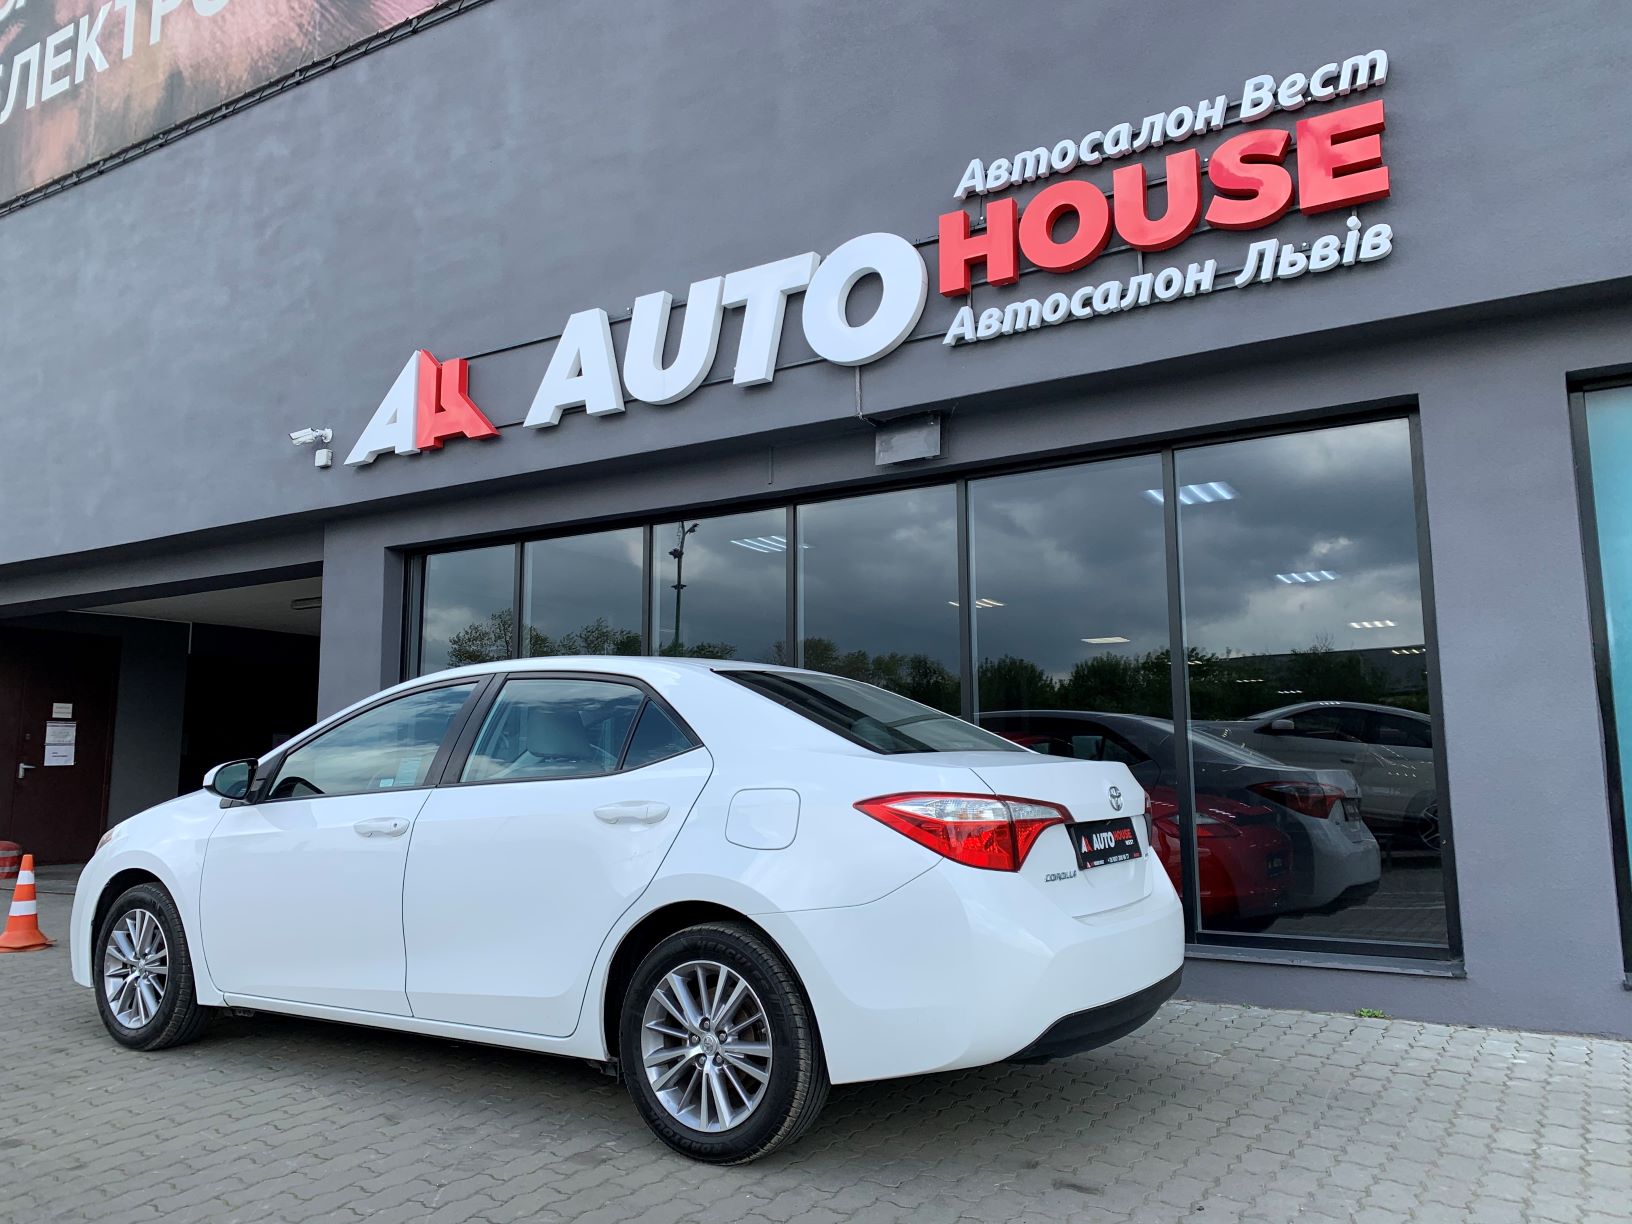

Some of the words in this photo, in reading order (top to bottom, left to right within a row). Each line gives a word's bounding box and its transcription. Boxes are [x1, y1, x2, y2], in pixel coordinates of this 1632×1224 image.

[953, 94, 1228, 200] Автосалон
[1239, 49, 1389, 123] Вест
[523, 232, 929, 430] AUTO
[938, 99, 1392, 298] HOUSE
[942, 258, 1218, 347] Автосалон
[1234, 215, 1394, 289] Львів
